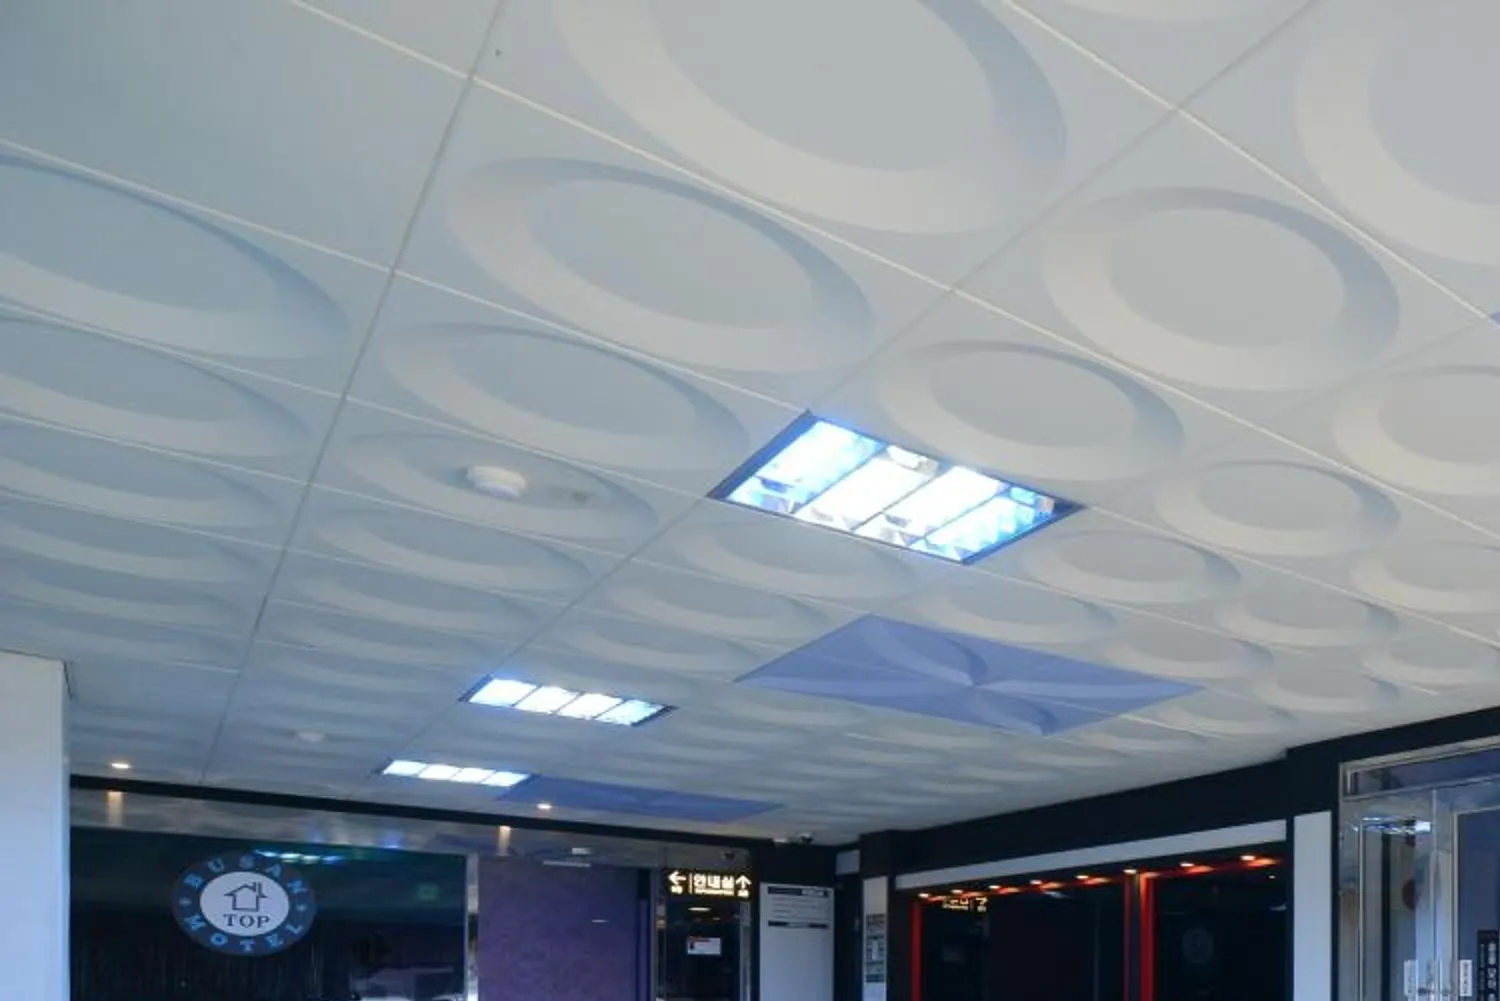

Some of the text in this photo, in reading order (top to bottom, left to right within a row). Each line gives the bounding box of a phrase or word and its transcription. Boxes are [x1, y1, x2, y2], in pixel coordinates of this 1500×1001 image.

[184, 856, 307, 893] BUSAN
[184, 915, 303, 951] MOTEL
[223, 913, 270, 929] TOP
